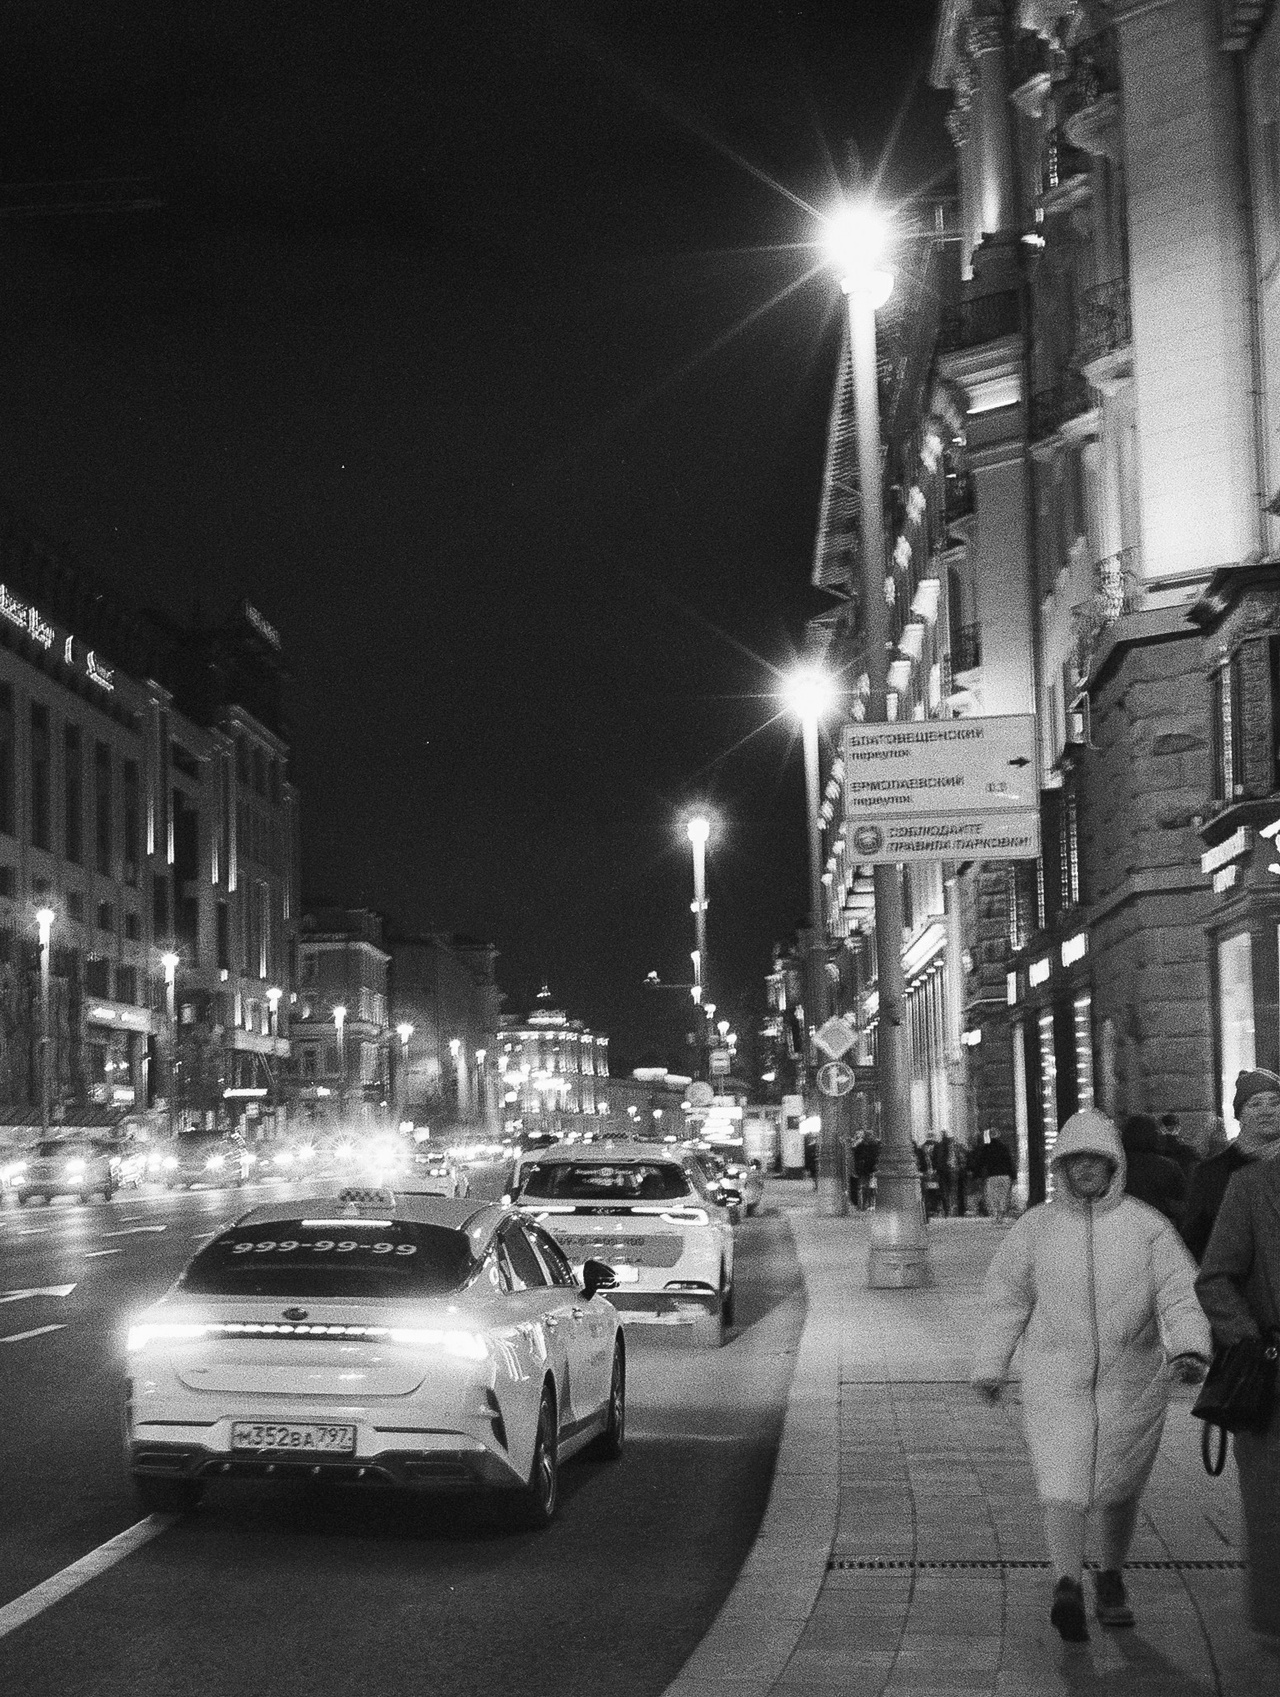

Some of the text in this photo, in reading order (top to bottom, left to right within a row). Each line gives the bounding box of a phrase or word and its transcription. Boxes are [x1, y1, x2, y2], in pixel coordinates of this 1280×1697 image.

[850, 728, 984, 748] БЛАГОВЕЩЕНСКИЙ
[851, 748, 910, 762] переулок
[851, 775, 965, 793] ЕРМОЛАЕВСКИЙ
[851, 795, 912, 808] переулок
[887, 840, 951, 853] ПРАВИЛА
